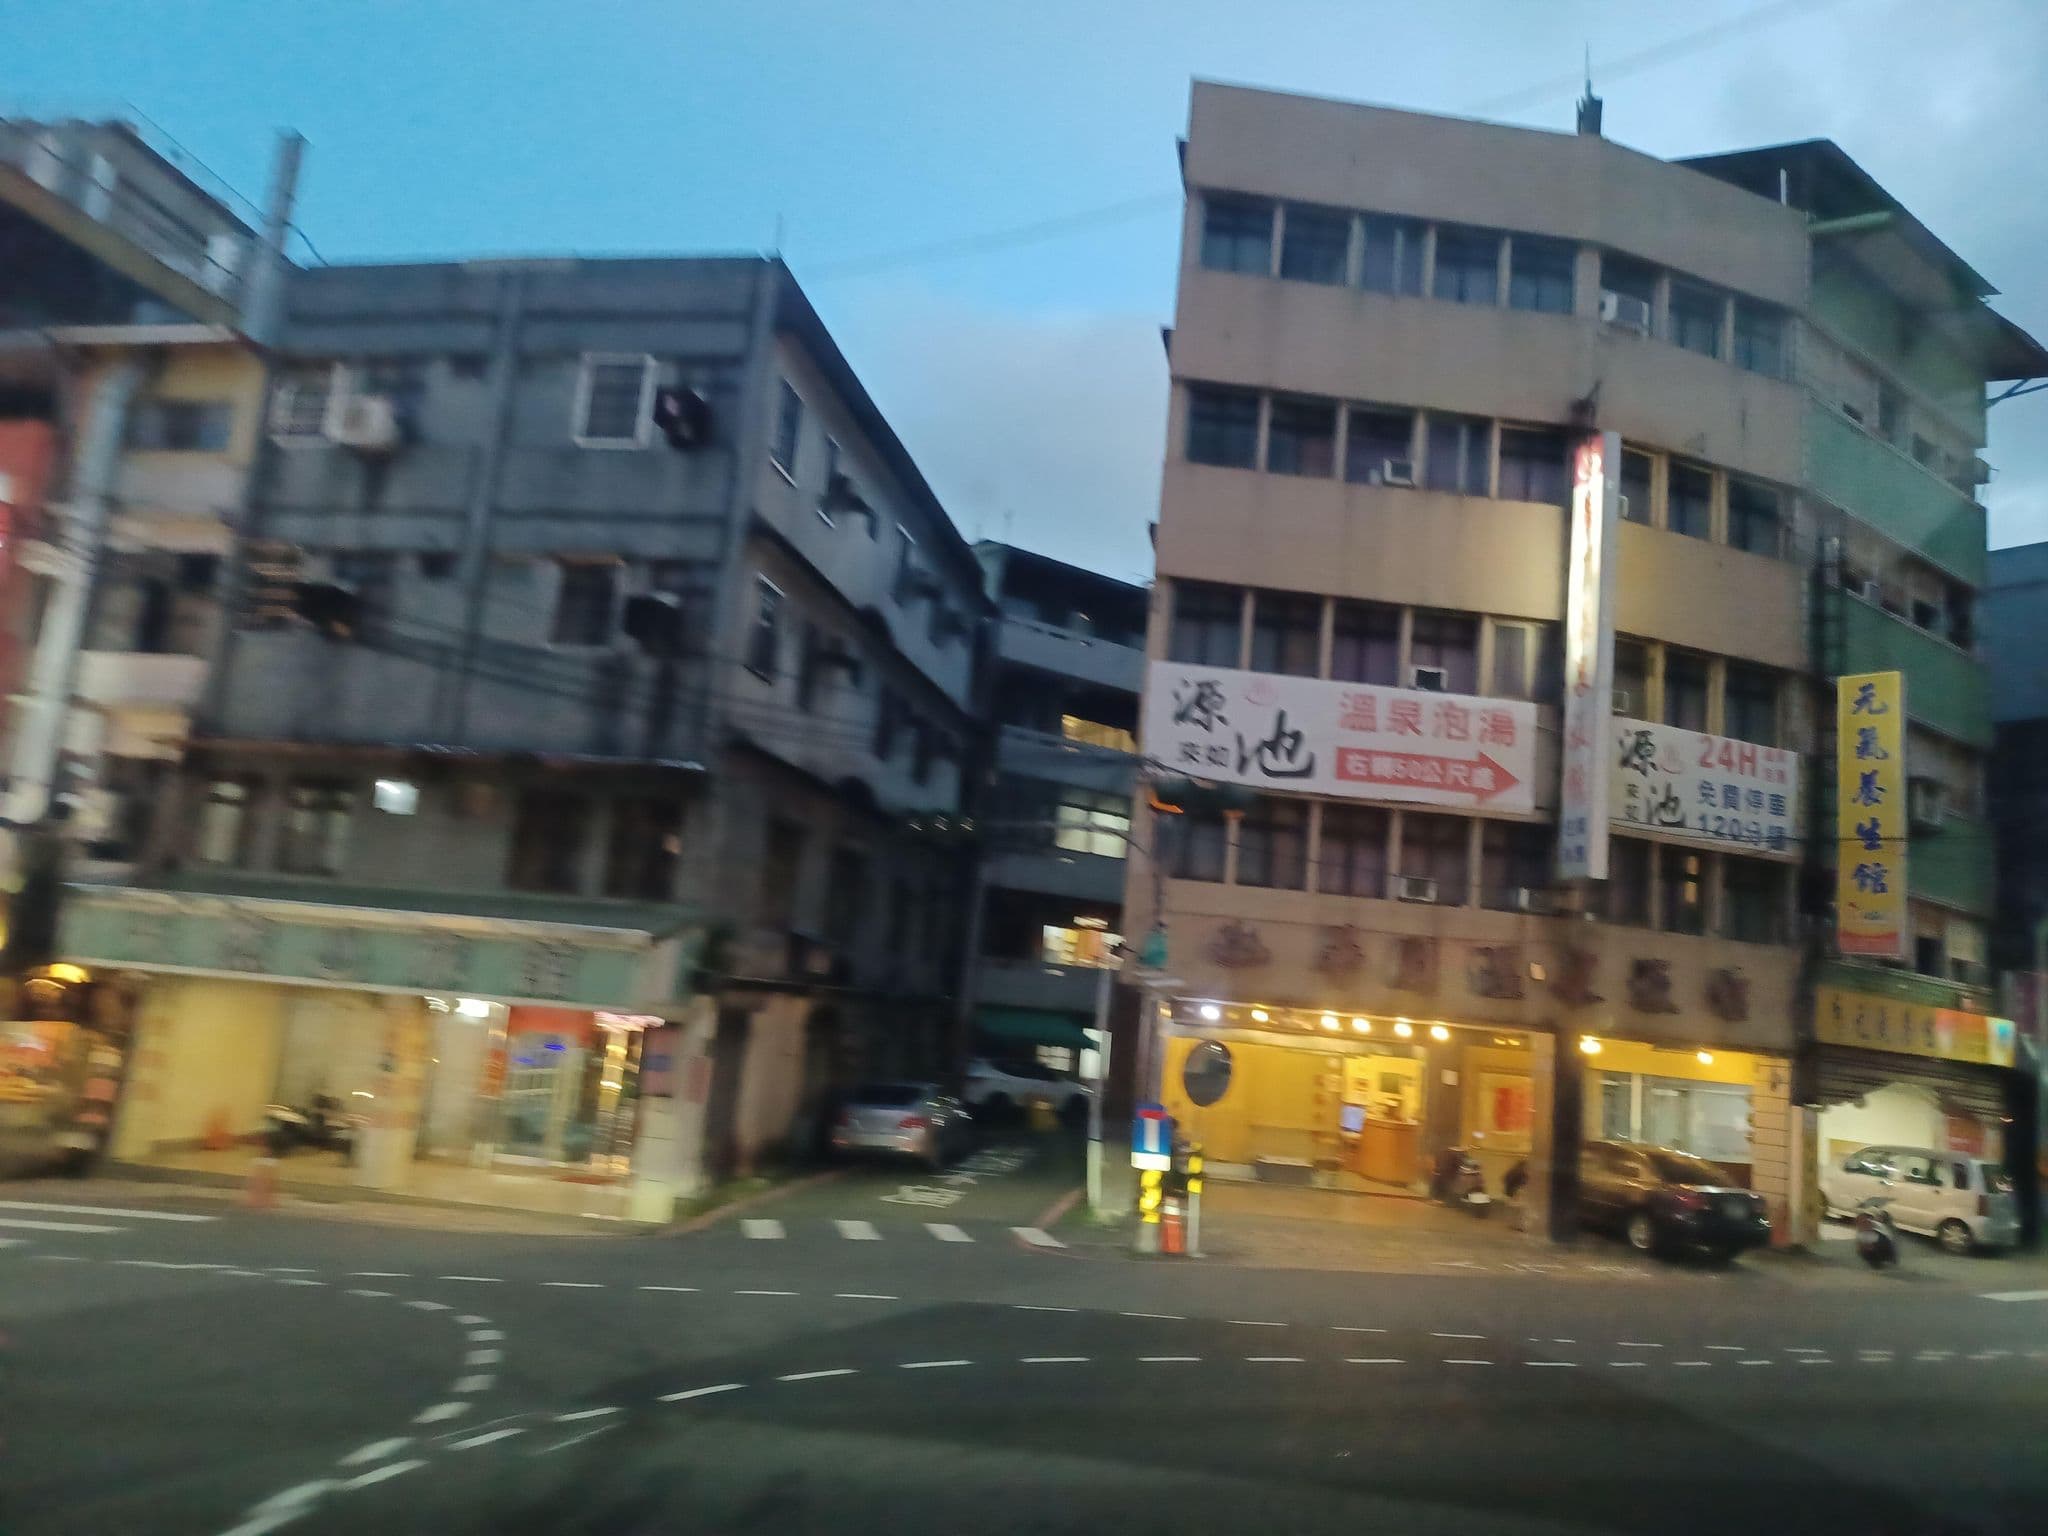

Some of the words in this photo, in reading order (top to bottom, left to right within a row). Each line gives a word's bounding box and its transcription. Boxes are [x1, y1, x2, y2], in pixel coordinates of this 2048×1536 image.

[1339, 690, 1516, 747] 溫泉泡湯
[1697, 735, 1758, 777] 24H
[1851, 683, 1889, 894] 元氣養生館
